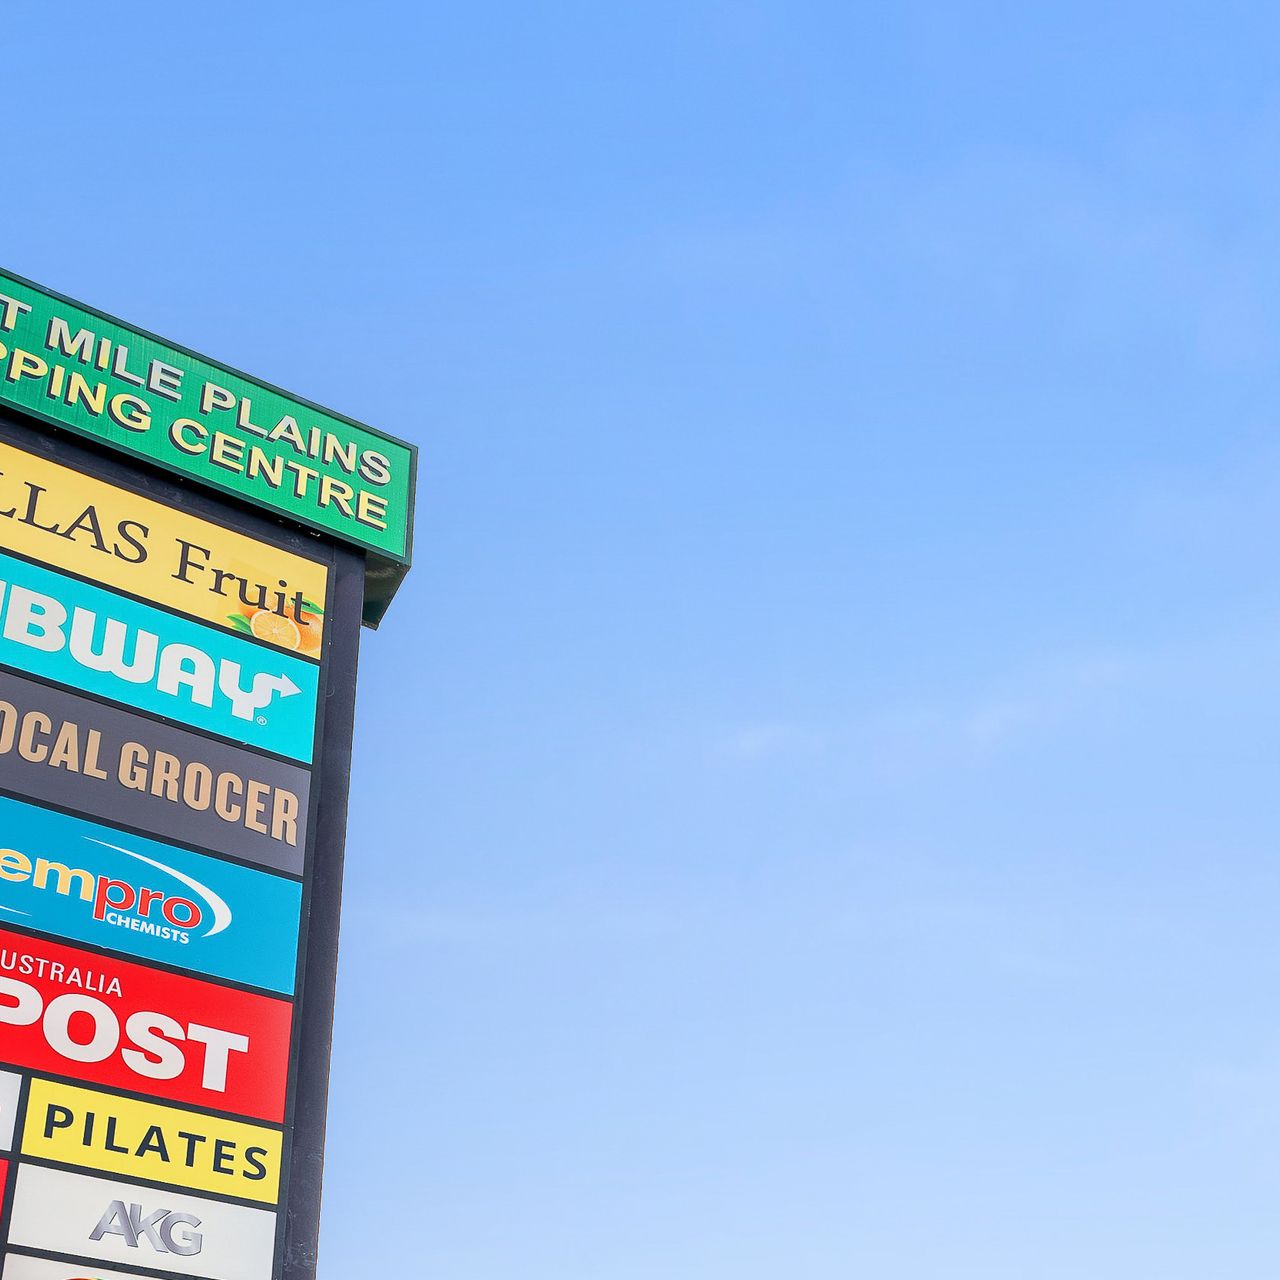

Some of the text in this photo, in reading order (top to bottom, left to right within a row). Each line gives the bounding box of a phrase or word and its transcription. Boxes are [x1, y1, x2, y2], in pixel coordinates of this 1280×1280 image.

[46, 316, 186, 401] MILE
[199, 381, 393, 487] PLAINS
[169, 418, 390, 532] CENTRE
[172, 537, 311, 626] Fruit
[118, 741, 301, 849] GROCER
[106, 911, 190, 945] CHEMISTS
[45, 1103, 270, 1182] PILATES
[88, 1198, 203, 1258] AKG
